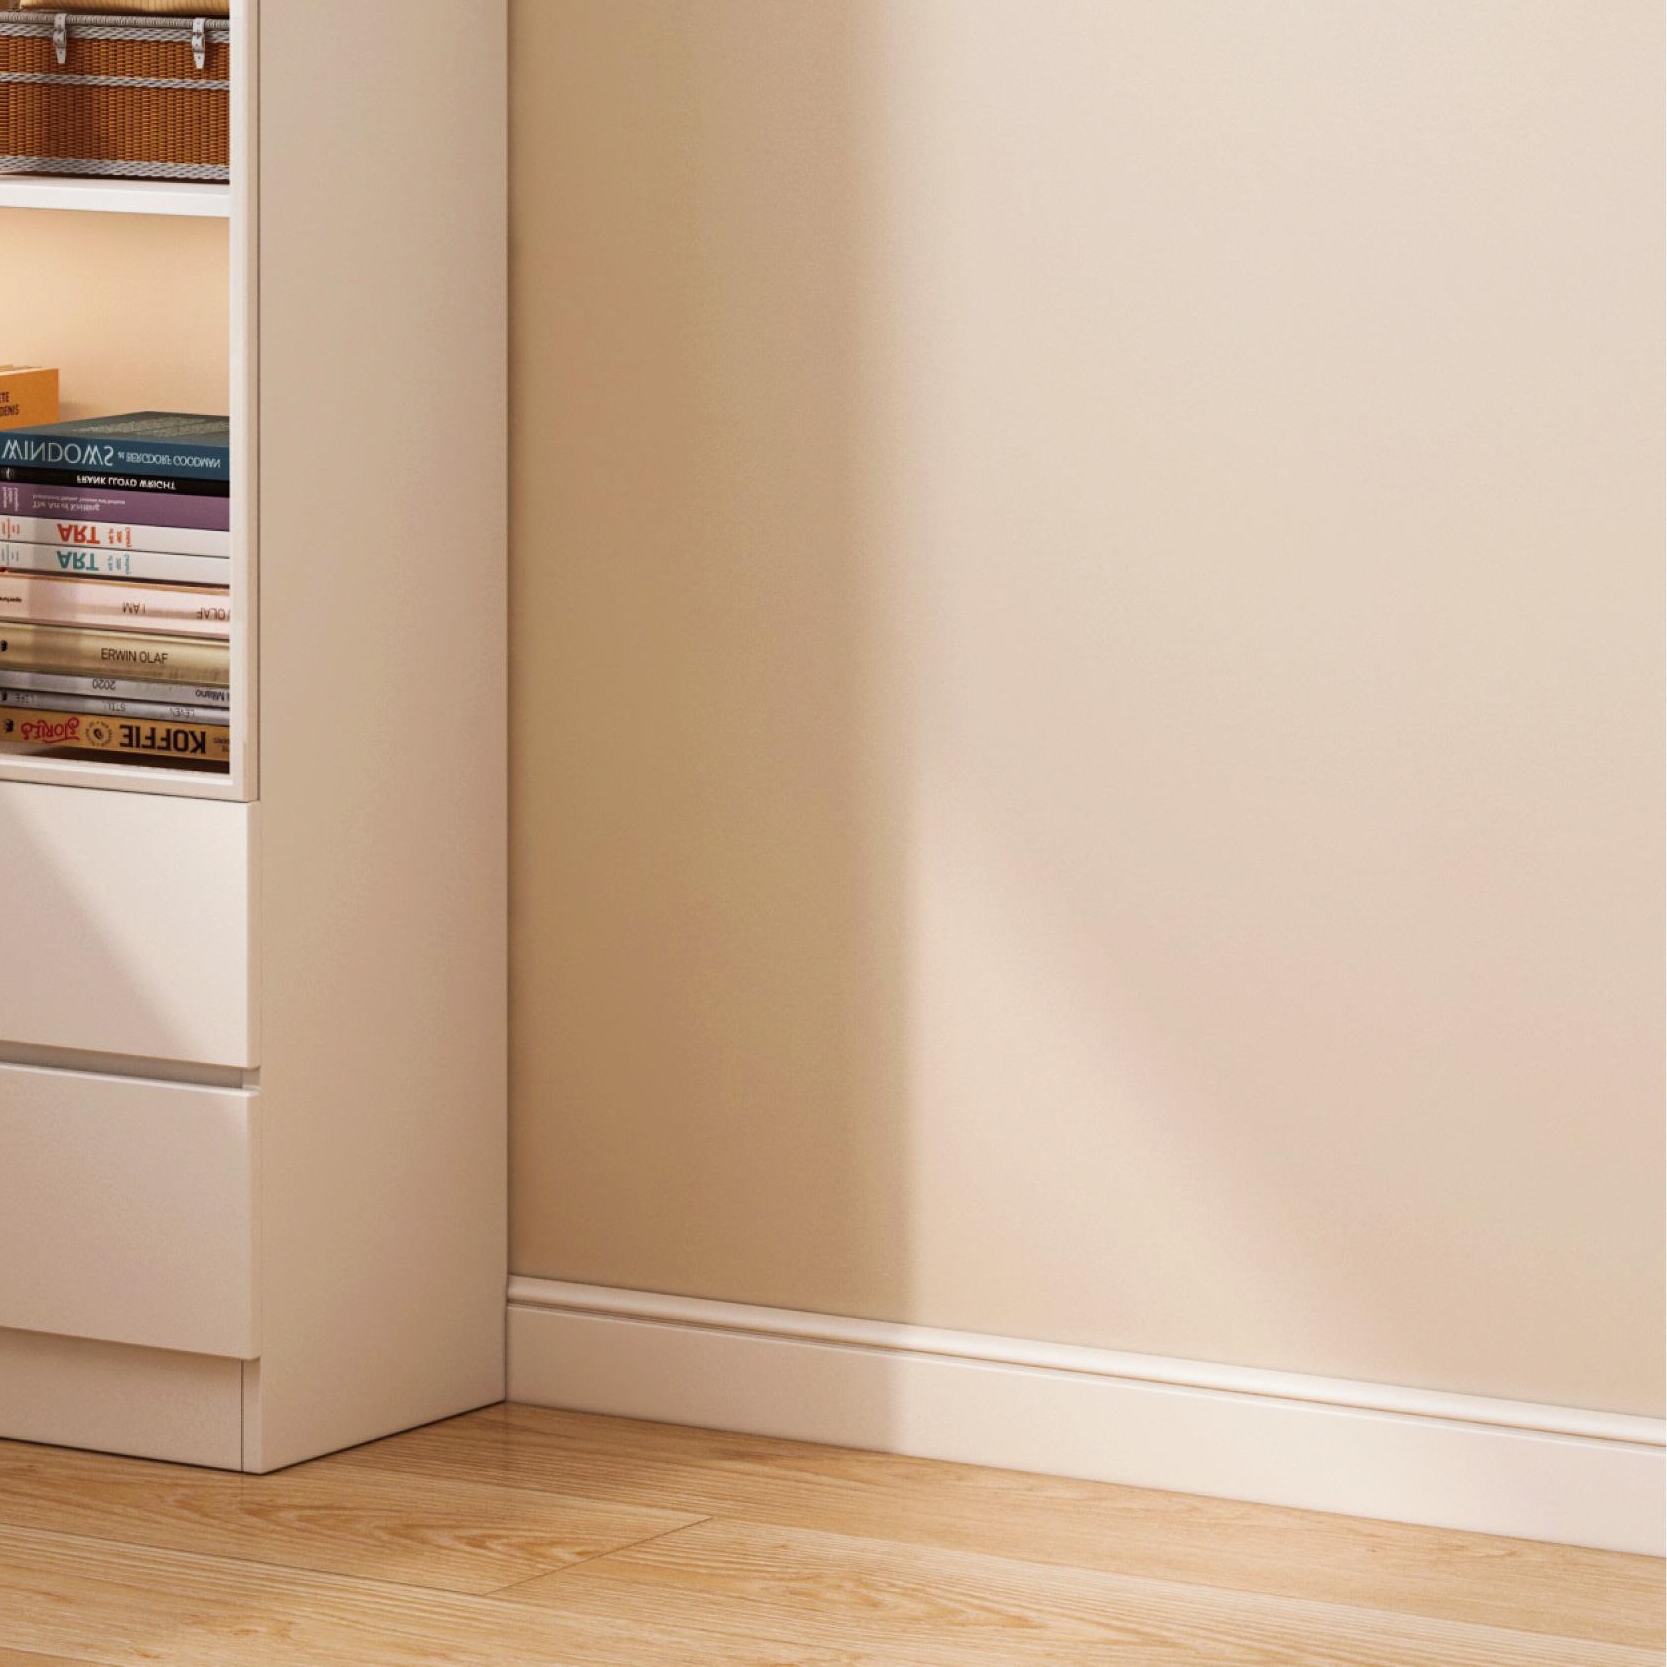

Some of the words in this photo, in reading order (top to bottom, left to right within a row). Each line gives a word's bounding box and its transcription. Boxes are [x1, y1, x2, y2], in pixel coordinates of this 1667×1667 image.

[121, 601, 140, 614] AM
[197, 606, 224, 619] OLAF
[100, 647, 137, 662] ERWIN
[140, 649, 169, 665] OLAF
[93, 677, 116, 689] 2020
[195, 689, 221, 701] Milano
[20, 717, 80, 743] STORIES
[119, 723, 207, 754] KOFFIE
